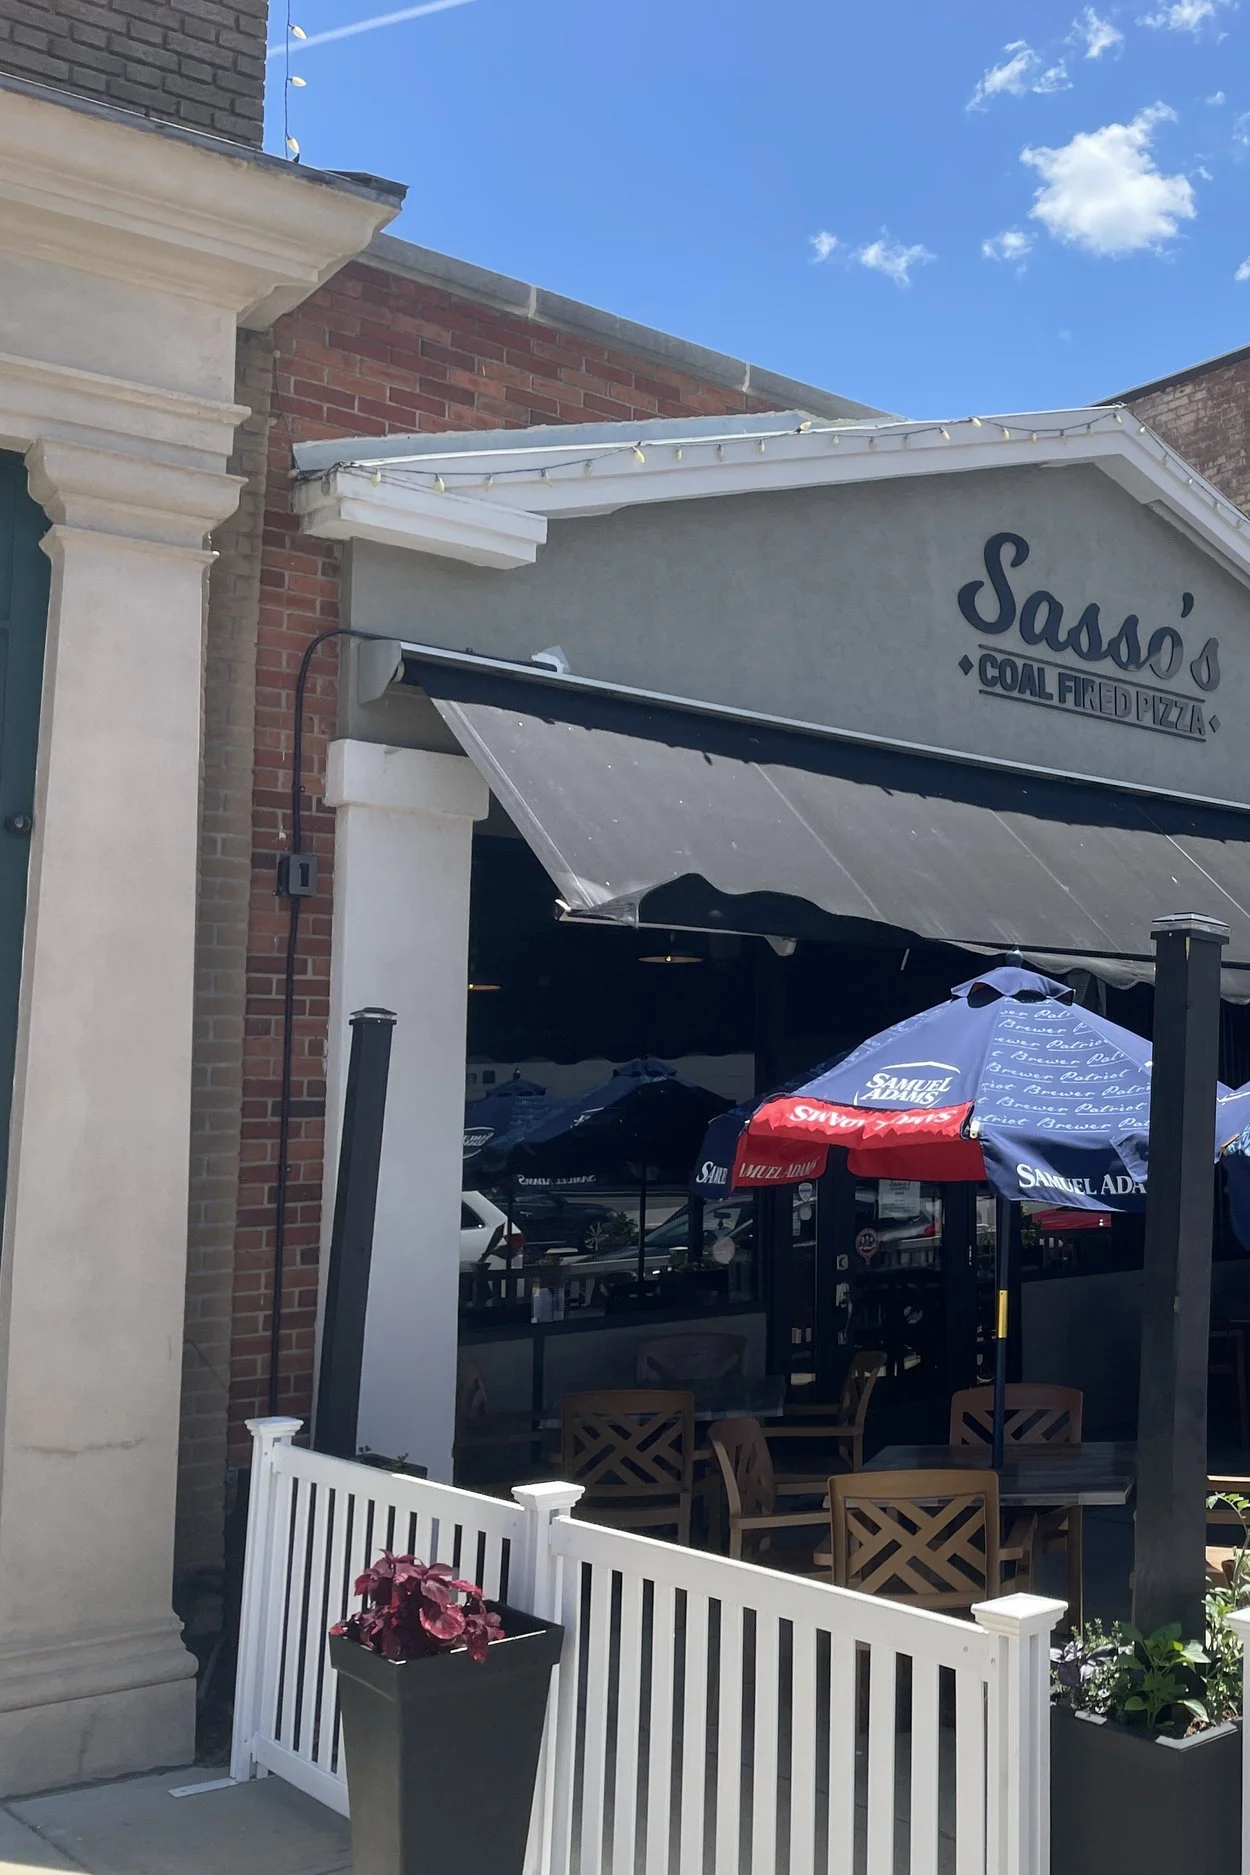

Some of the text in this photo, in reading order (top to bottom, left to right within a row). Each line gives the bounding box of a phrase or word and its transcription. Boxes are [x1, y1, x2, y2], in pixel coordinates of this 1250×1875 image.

[957, 532, 1221, 691] Sasso's
[978, 653, 1206, 735] COAL FIRED PIZZA
[999, 1019, 1067, 1034] Brewer
[1010, 1051, 1080, 1065] Brewer
[986, 1062, 1130, 1081] Brewer Patriot
[866, 1073, 953, 1092] SAMUEL
[1024, 1084, 1095, 1097] Brewer
[860, 1088, 938, 1104] ADAMS
[996, 1097, 1068, 1112] Brewer
[1075, 1102, 1147, 1113] Patriot
[1037, 1117, 1112, 1130] Brewer
[1016, 1163, 1097, 1195] SAMUEL
